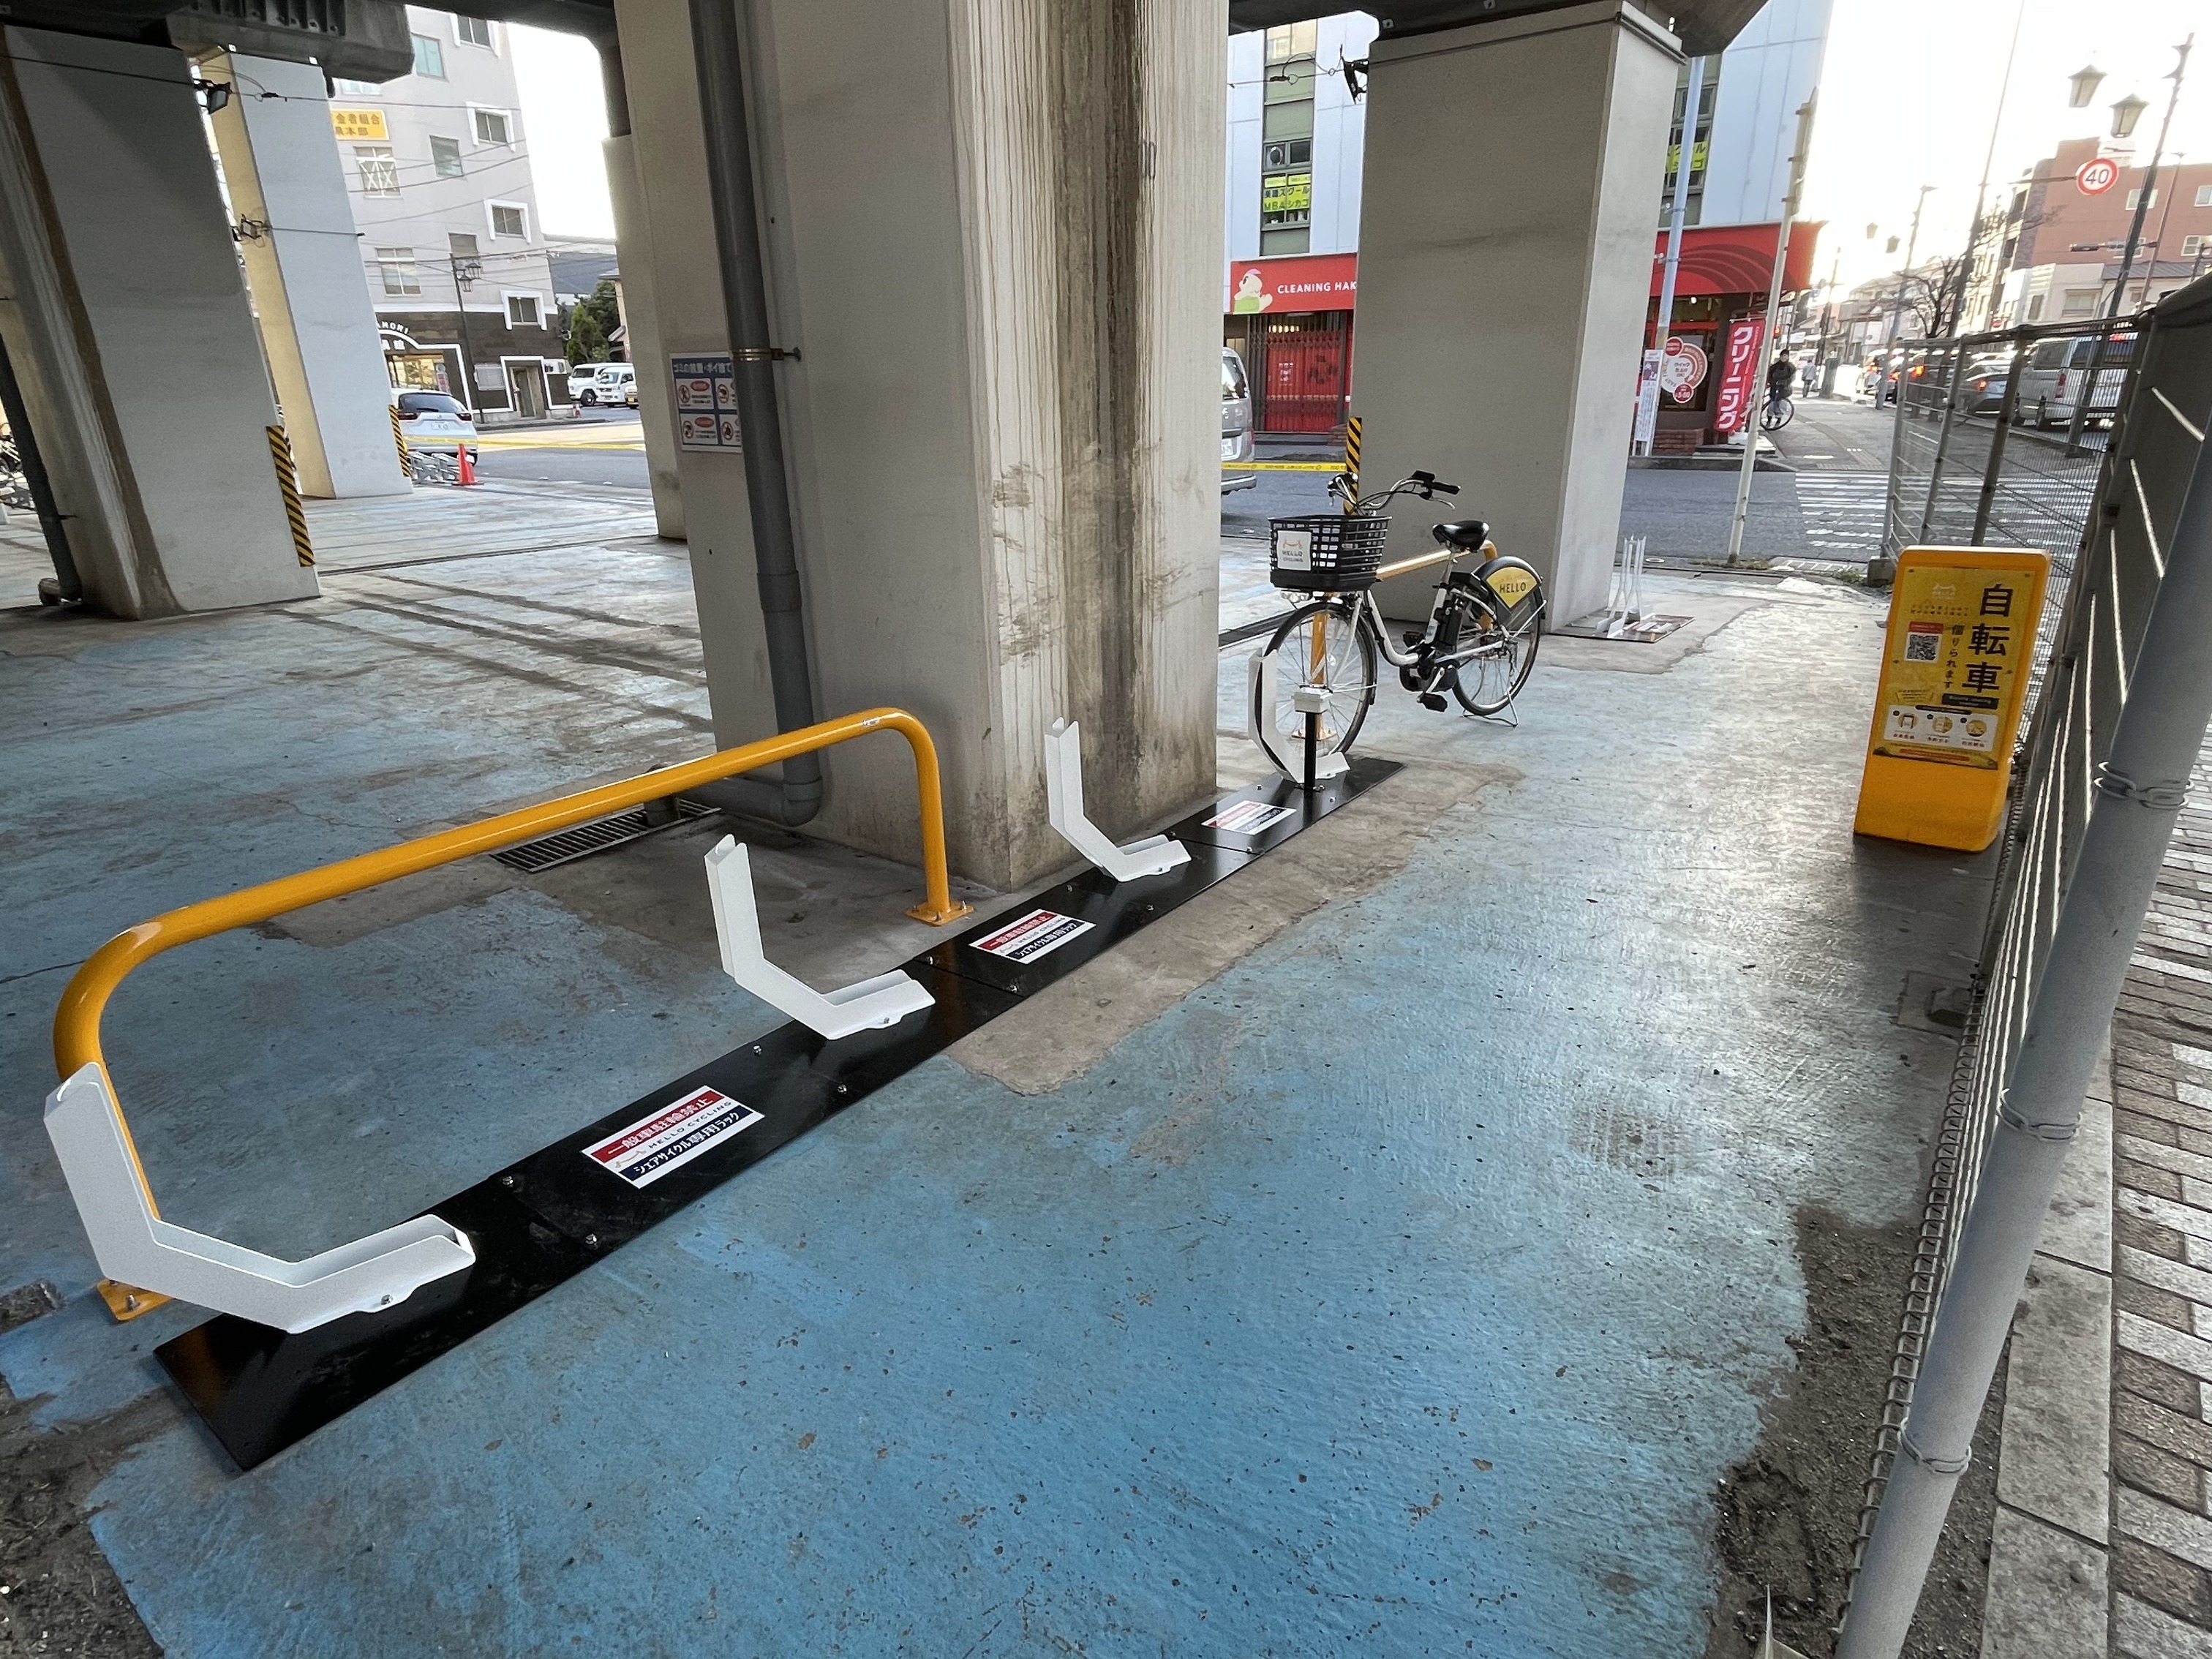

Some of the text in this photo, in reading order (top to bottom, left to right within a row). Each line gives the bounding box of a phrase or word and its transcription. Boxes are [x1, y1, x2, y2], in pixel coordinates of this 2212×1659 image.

[333, 113, 380, 125] 金者組合
[2085, 168, 2110, 185] 40
[1277, 282, 1331, 294] CLEANING
[377, 320, 410, 335] MORI
[1718, 326, 1753, 429] クリーニング
[1499, 582, 1527, 593] HELLO
[1944, 624, 1965, 689] 借りられます
[1962, 583, 2014, 693] 自転車
[607, 1096, 713, 1156] 一般車駐輪禁止
[633, 1112, 740, 1174] シェアサイクル専用ラック
[647, 1100, 732, 1149] HELLO CYCLING
